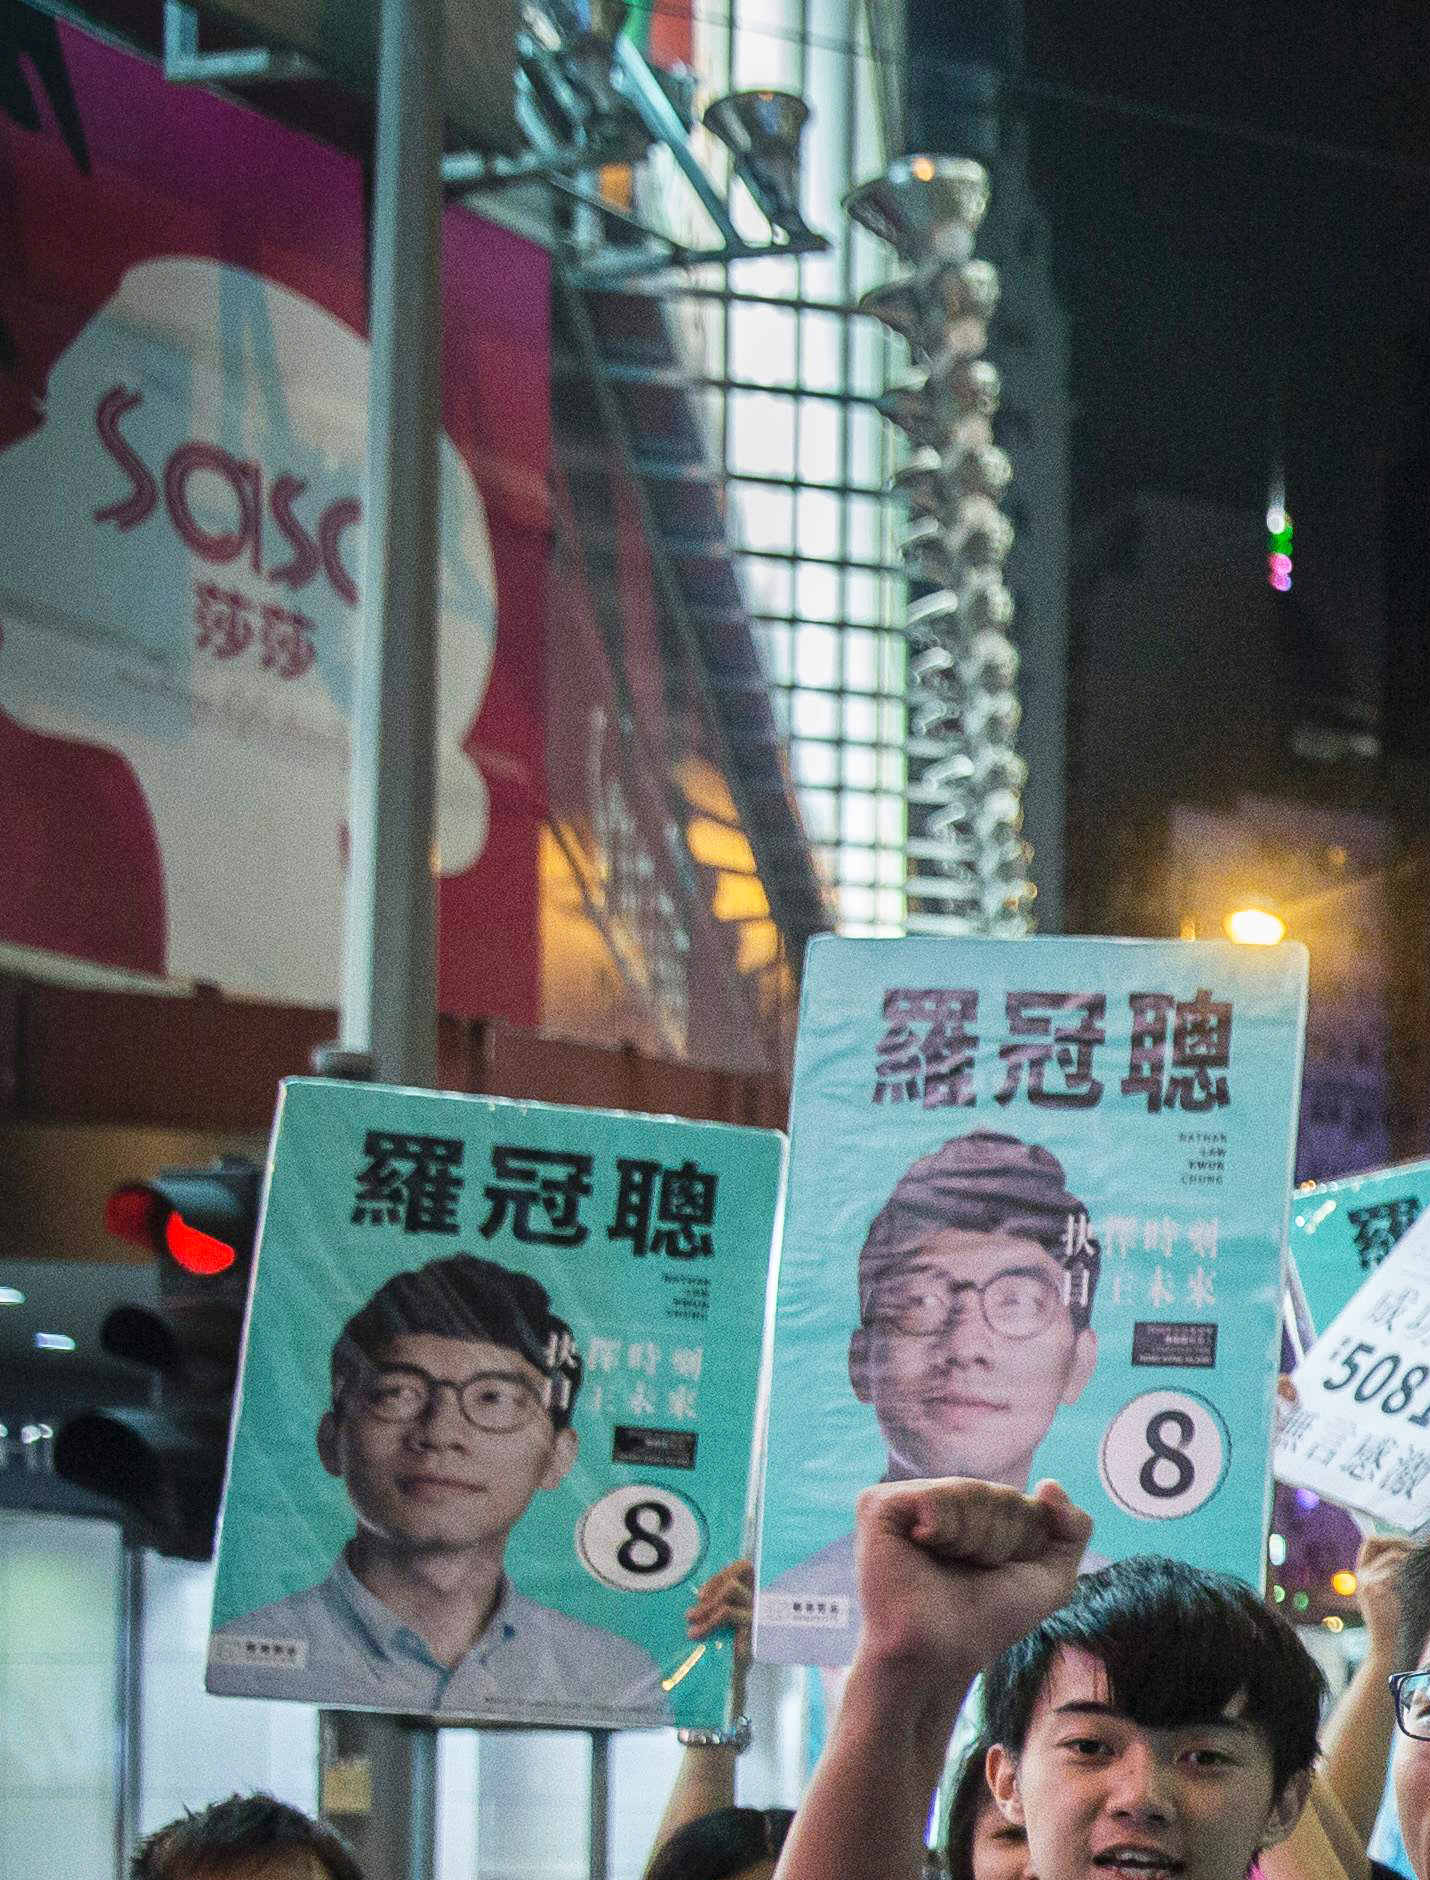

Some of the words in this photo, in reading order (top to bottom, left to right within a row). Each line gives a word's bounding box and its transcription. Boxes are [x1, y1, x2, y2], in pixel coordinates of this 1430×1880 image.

[872, 988, 1234, 1113] 羅冠聰
[351, 1130, 718, 1260] 羅冠聰
[1139, 1409, 1196, 1499] 8
[617, 1501, 673, 1574] 8
